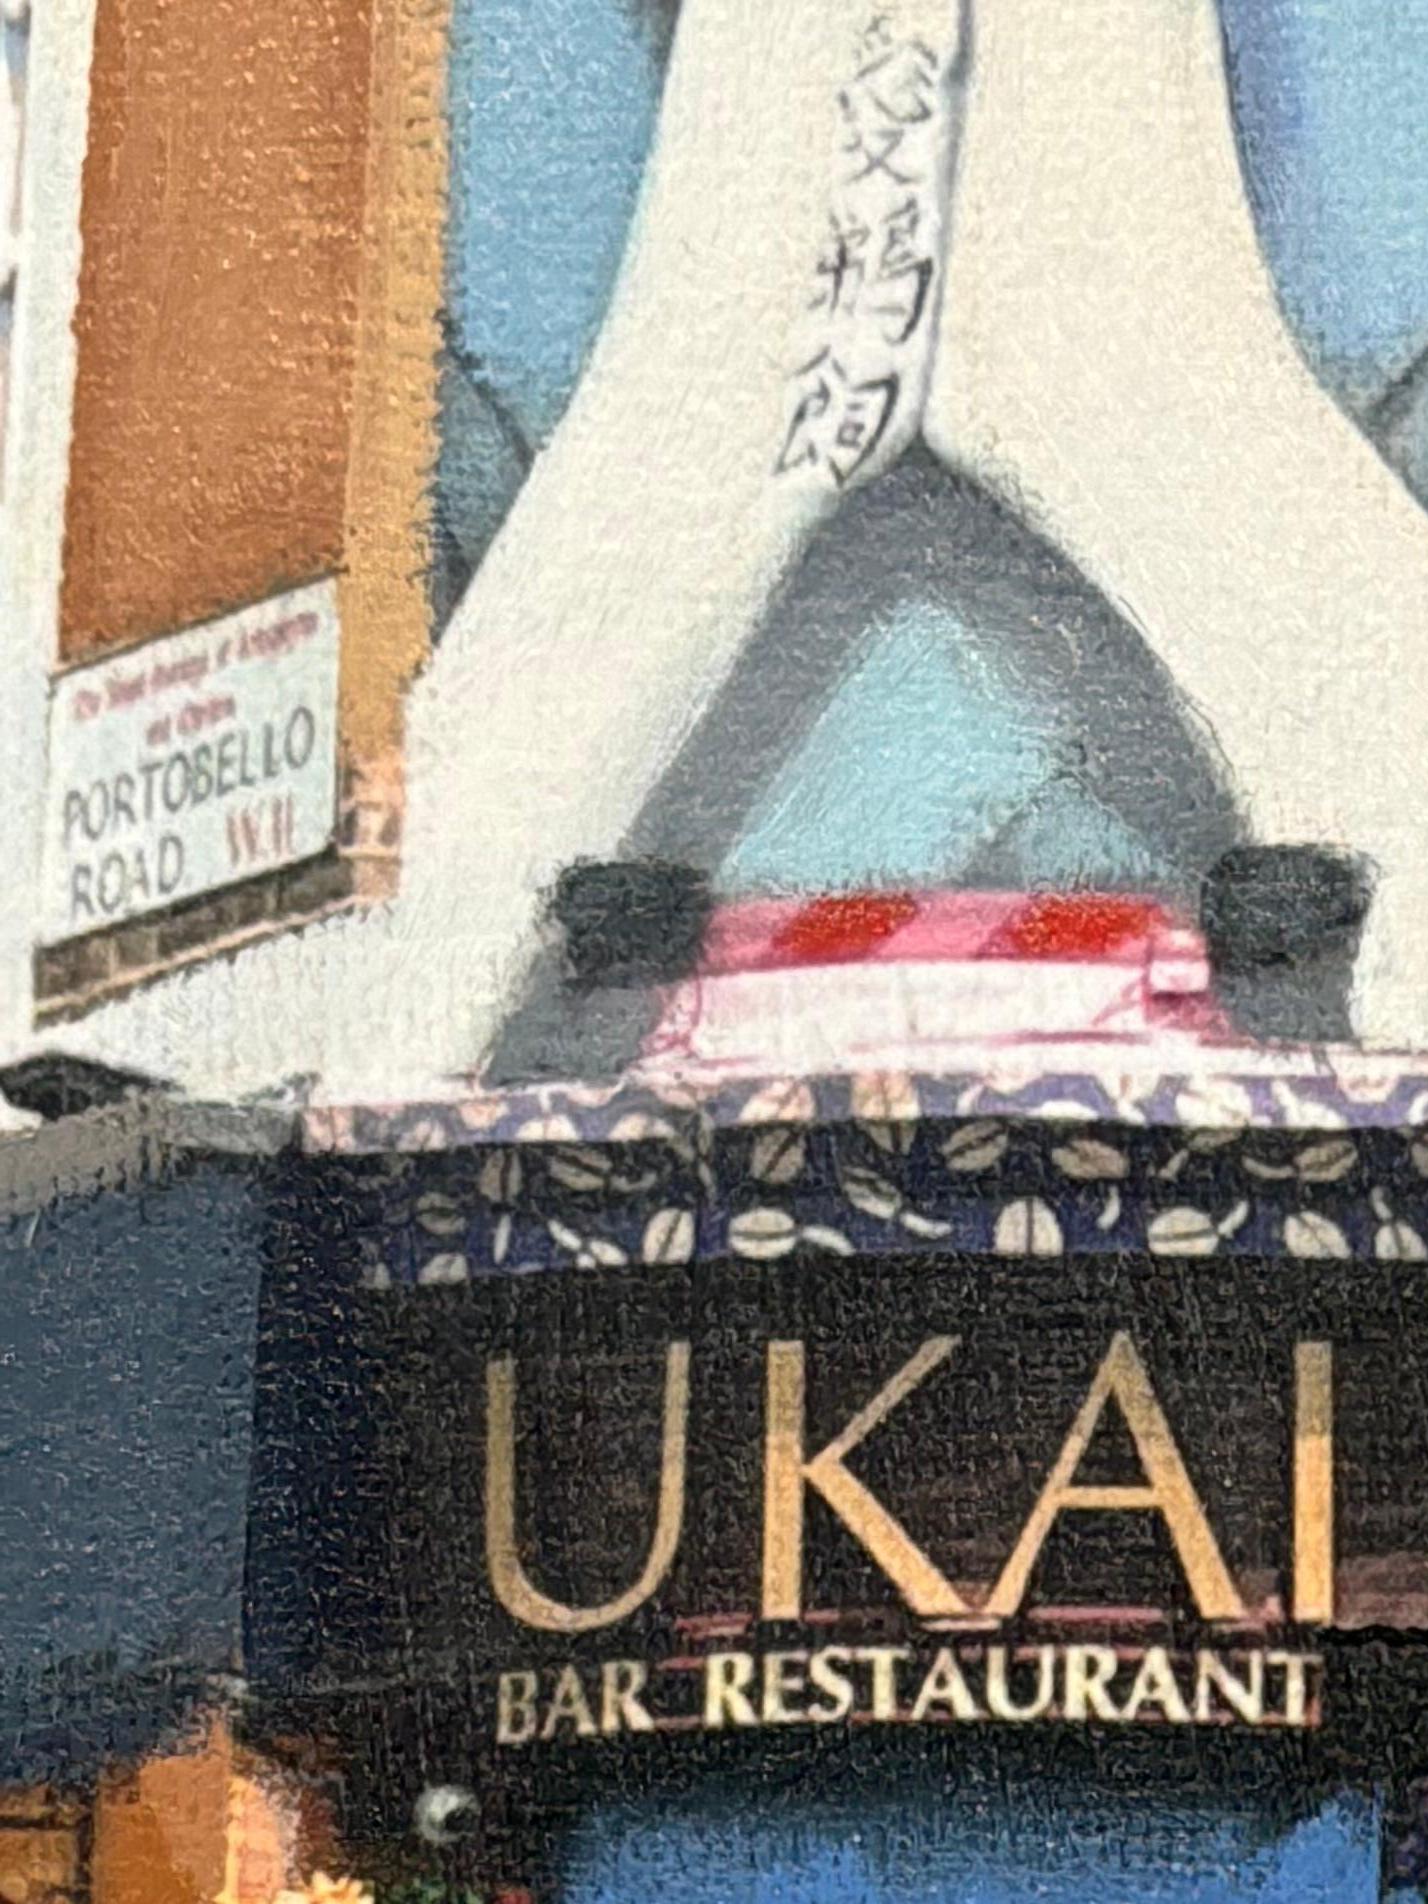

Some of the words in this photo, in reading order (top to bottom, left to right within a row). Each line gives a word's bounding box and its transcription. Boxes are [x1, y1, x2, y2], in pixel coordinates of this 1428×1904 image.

[62, 706, 316, 849] PORTOBELLO
[71, 834, 186, 924] ROAD
[484, 1330, 1334, 1632] UKAI
[496, 1658, 657, 1746] BAR
[702, 1642, 1326, 1728] RESTAURANT
